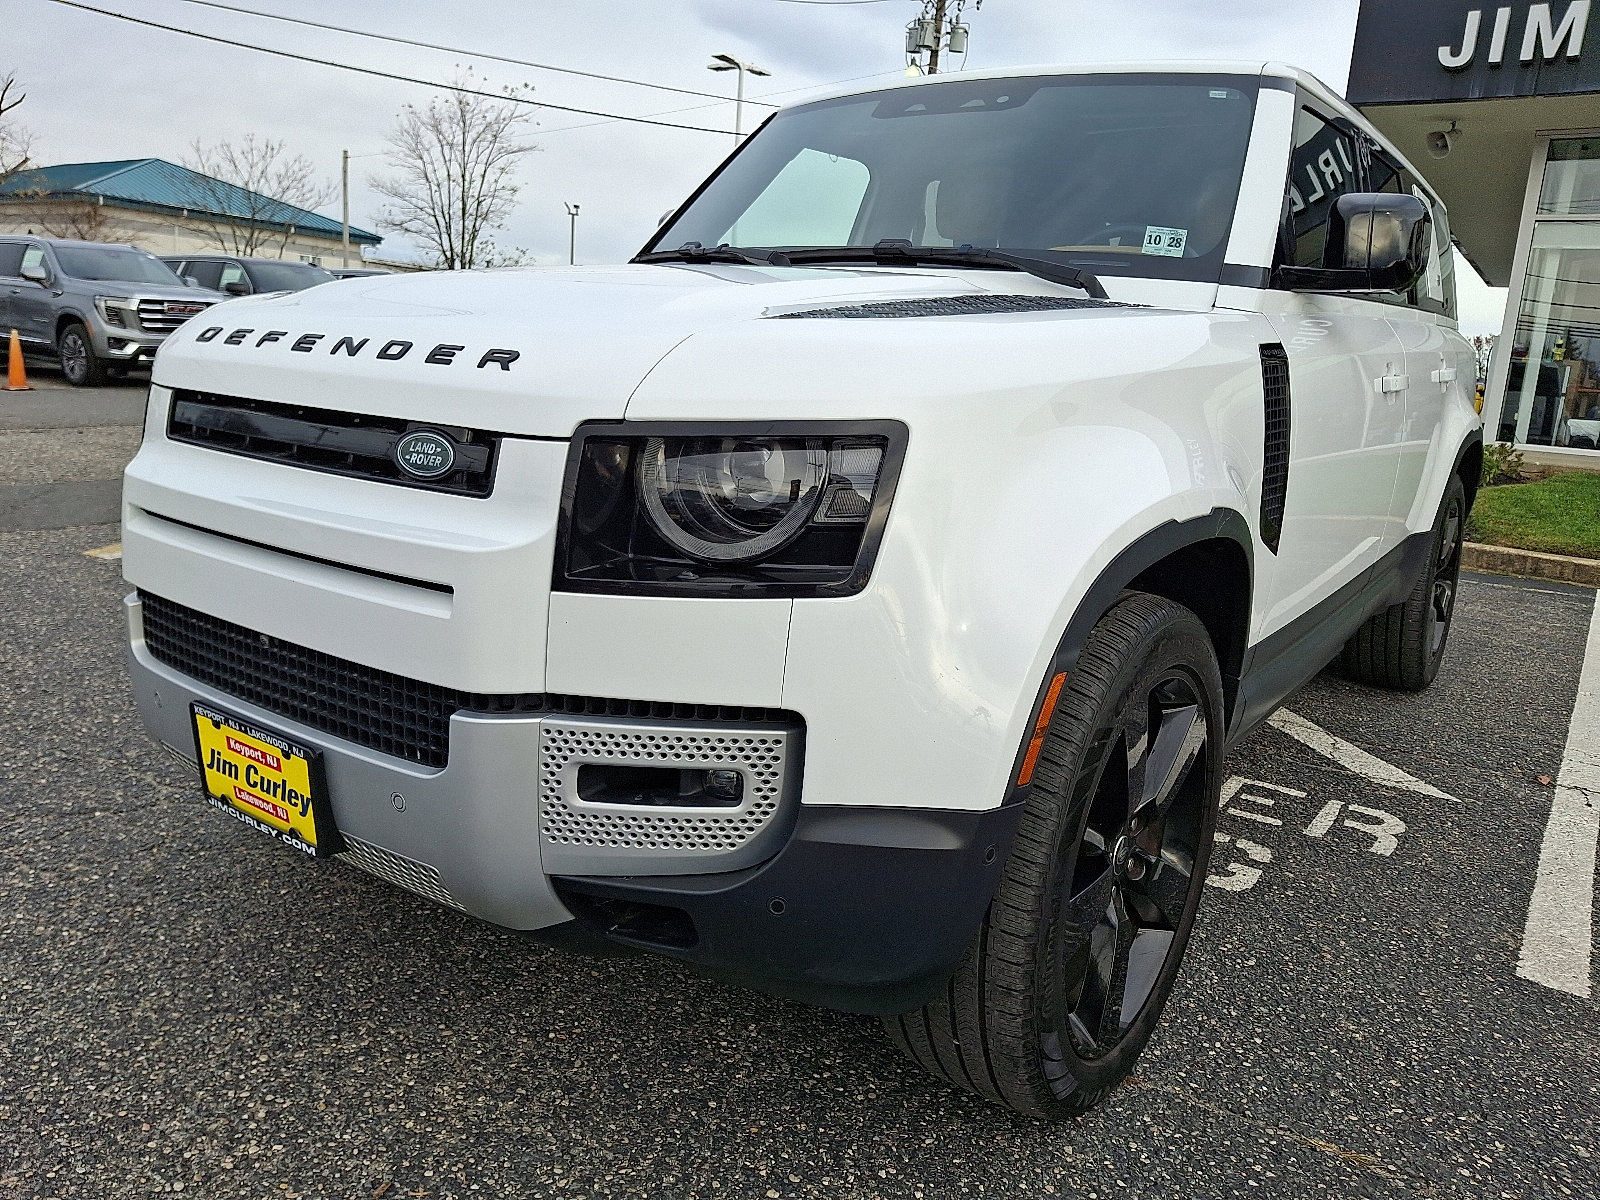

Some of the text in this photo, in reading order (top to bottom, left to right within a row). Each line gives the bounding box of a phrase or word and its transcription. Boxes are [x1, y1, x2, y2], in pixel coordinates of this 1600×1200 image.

[1437, 0, 1591, 68] JIM
[1146, 234, 1183, 249] 10 28
[195, 326, 521, 371] DEFENDER
[228, 719, 240, 731] NJ
[292, 746, 304, 758] NJ
[229, 738, 278, 768] Keyport, NJ
[206, 748, 312, 818] Jim Curley
[235, 787, 288, 821] Lakewood, NJ
[208, 797, 317, 857] JIMCURLEY.COM
